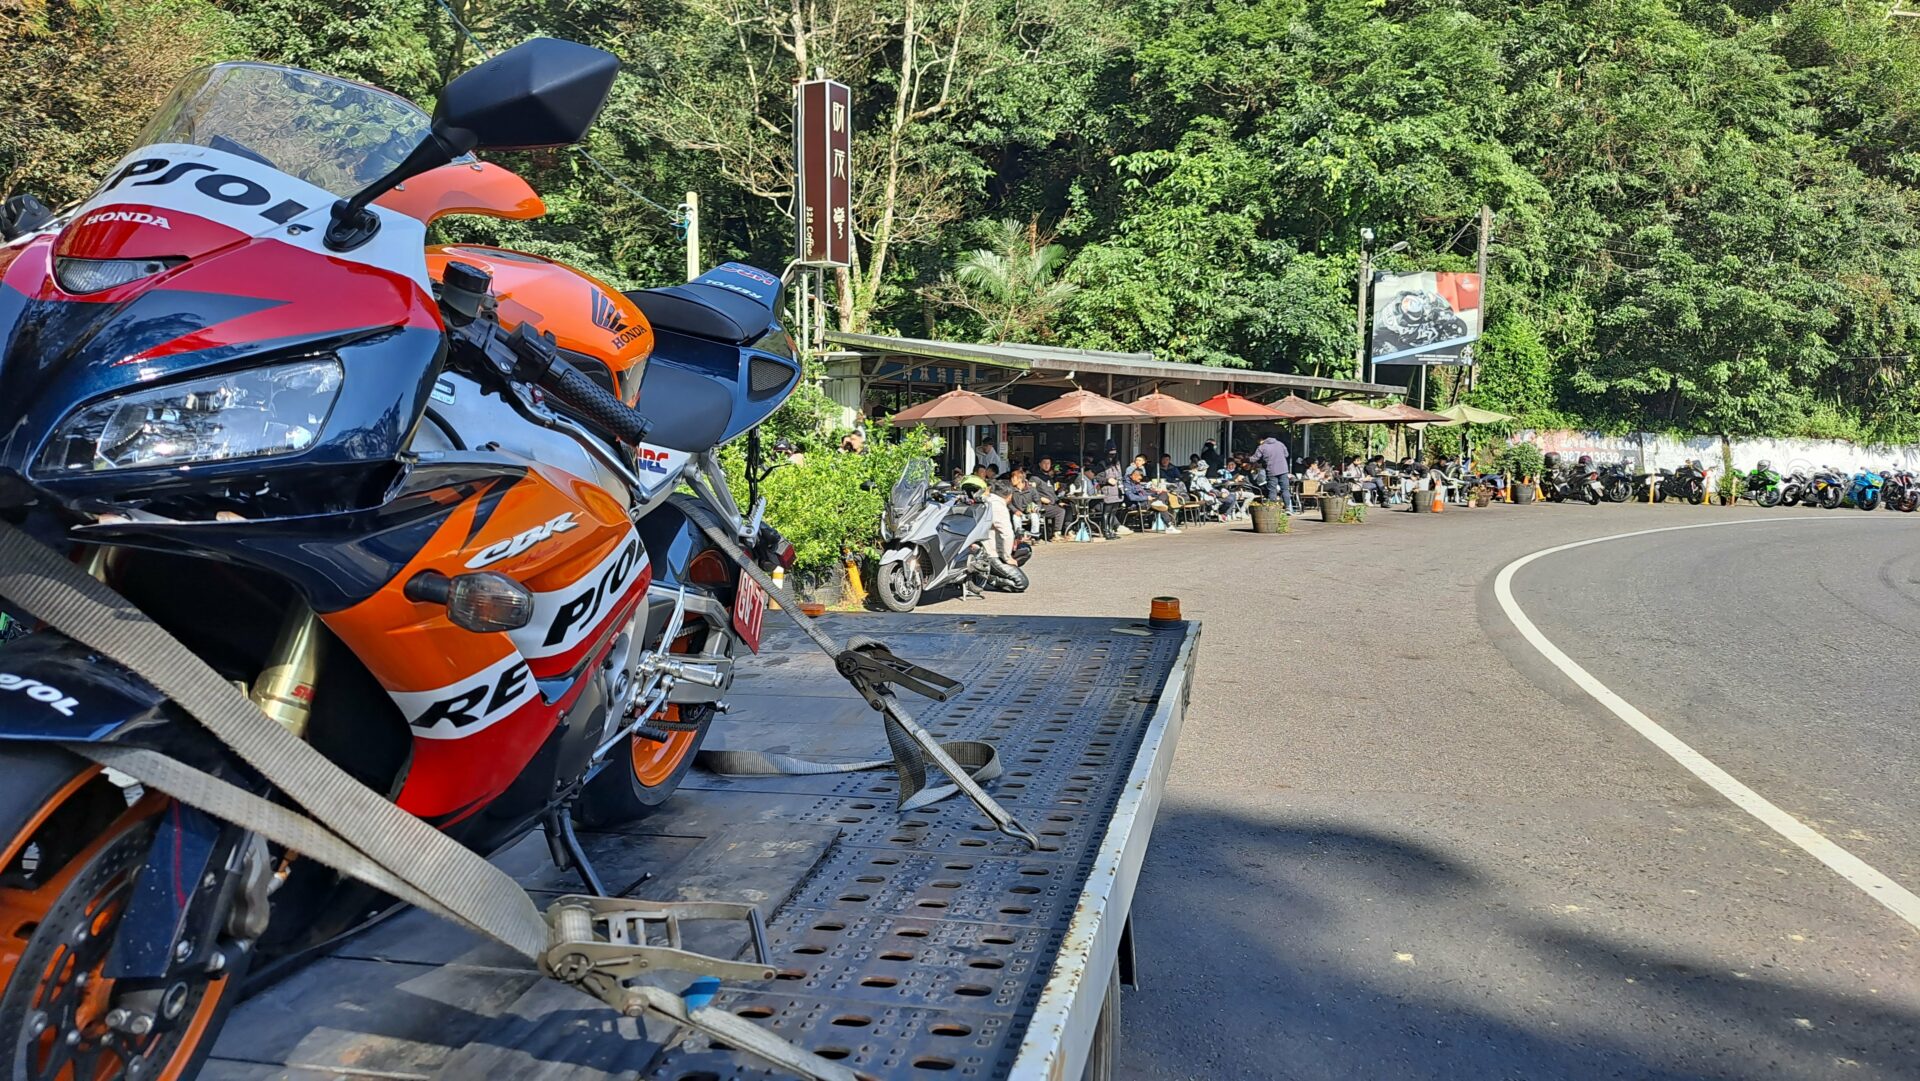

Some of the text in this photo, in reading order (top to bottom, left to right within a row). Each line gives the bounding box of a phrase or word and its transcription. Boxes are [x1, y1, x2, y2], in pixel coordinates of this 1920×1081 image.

[90, 158, 314, 233] PSOL
[83, 211, 172, 230] HONDA
[805, 226, 815, 257] Coffee
[611, 324, 648, 350] HONDA
[464, 512, 579, 569] CBR
